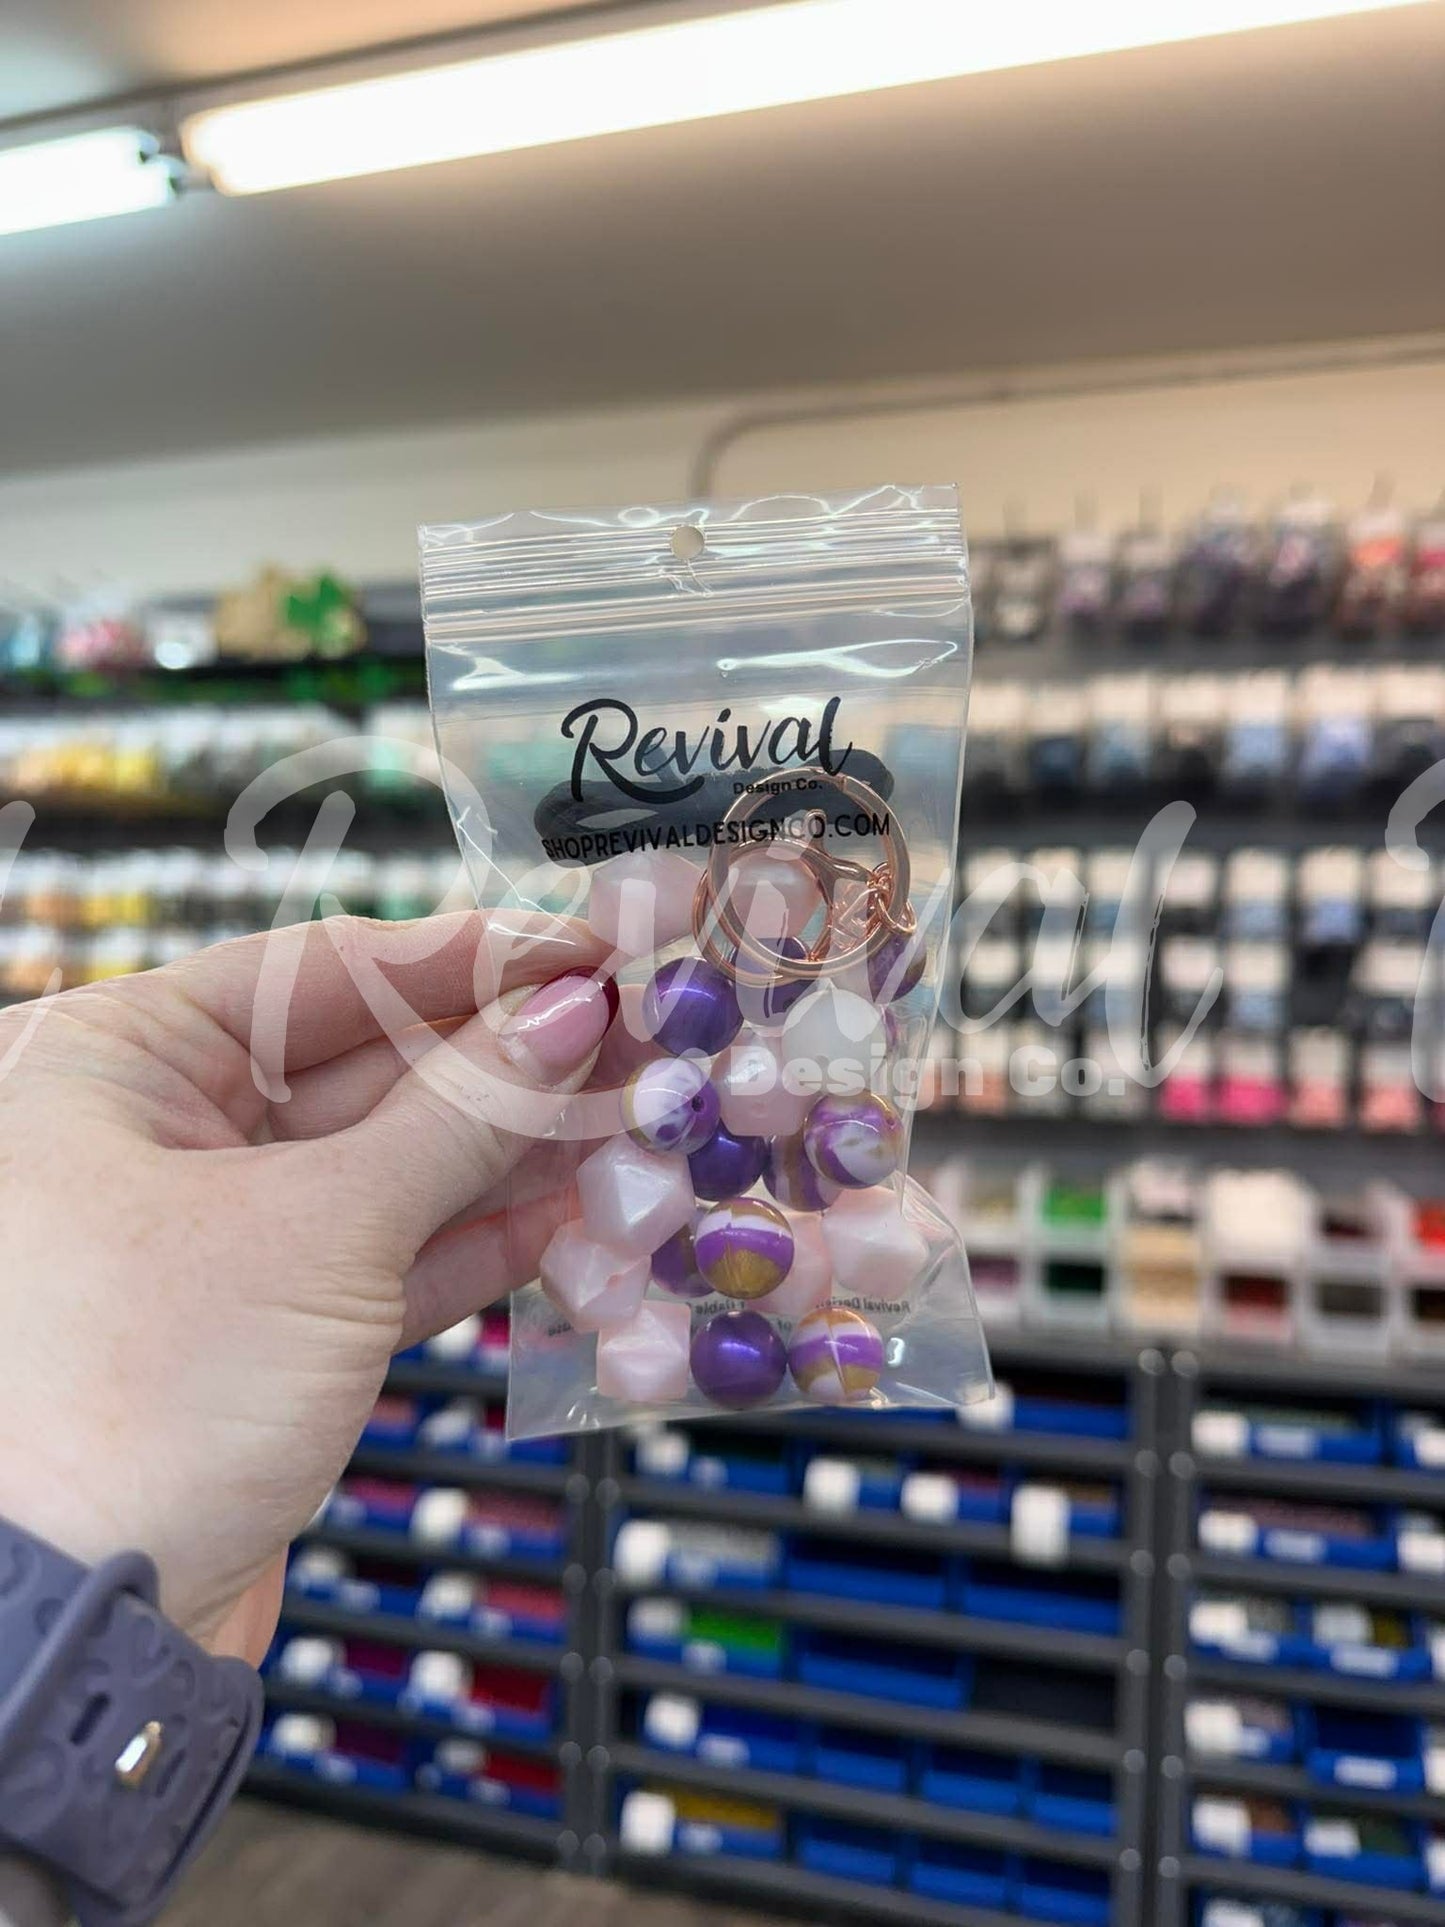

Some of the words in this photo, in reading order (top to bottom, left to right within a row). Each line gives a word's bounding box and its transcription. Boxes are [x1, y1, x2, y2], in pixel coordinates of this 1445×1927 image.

[561, 696, 853, 804] Revival
[733, 780, 792, 796] Design
[799, 777, 823, 791] Co.
[541, 813, 890, 861] SHOPREVIVALDESIGNCO.COM
